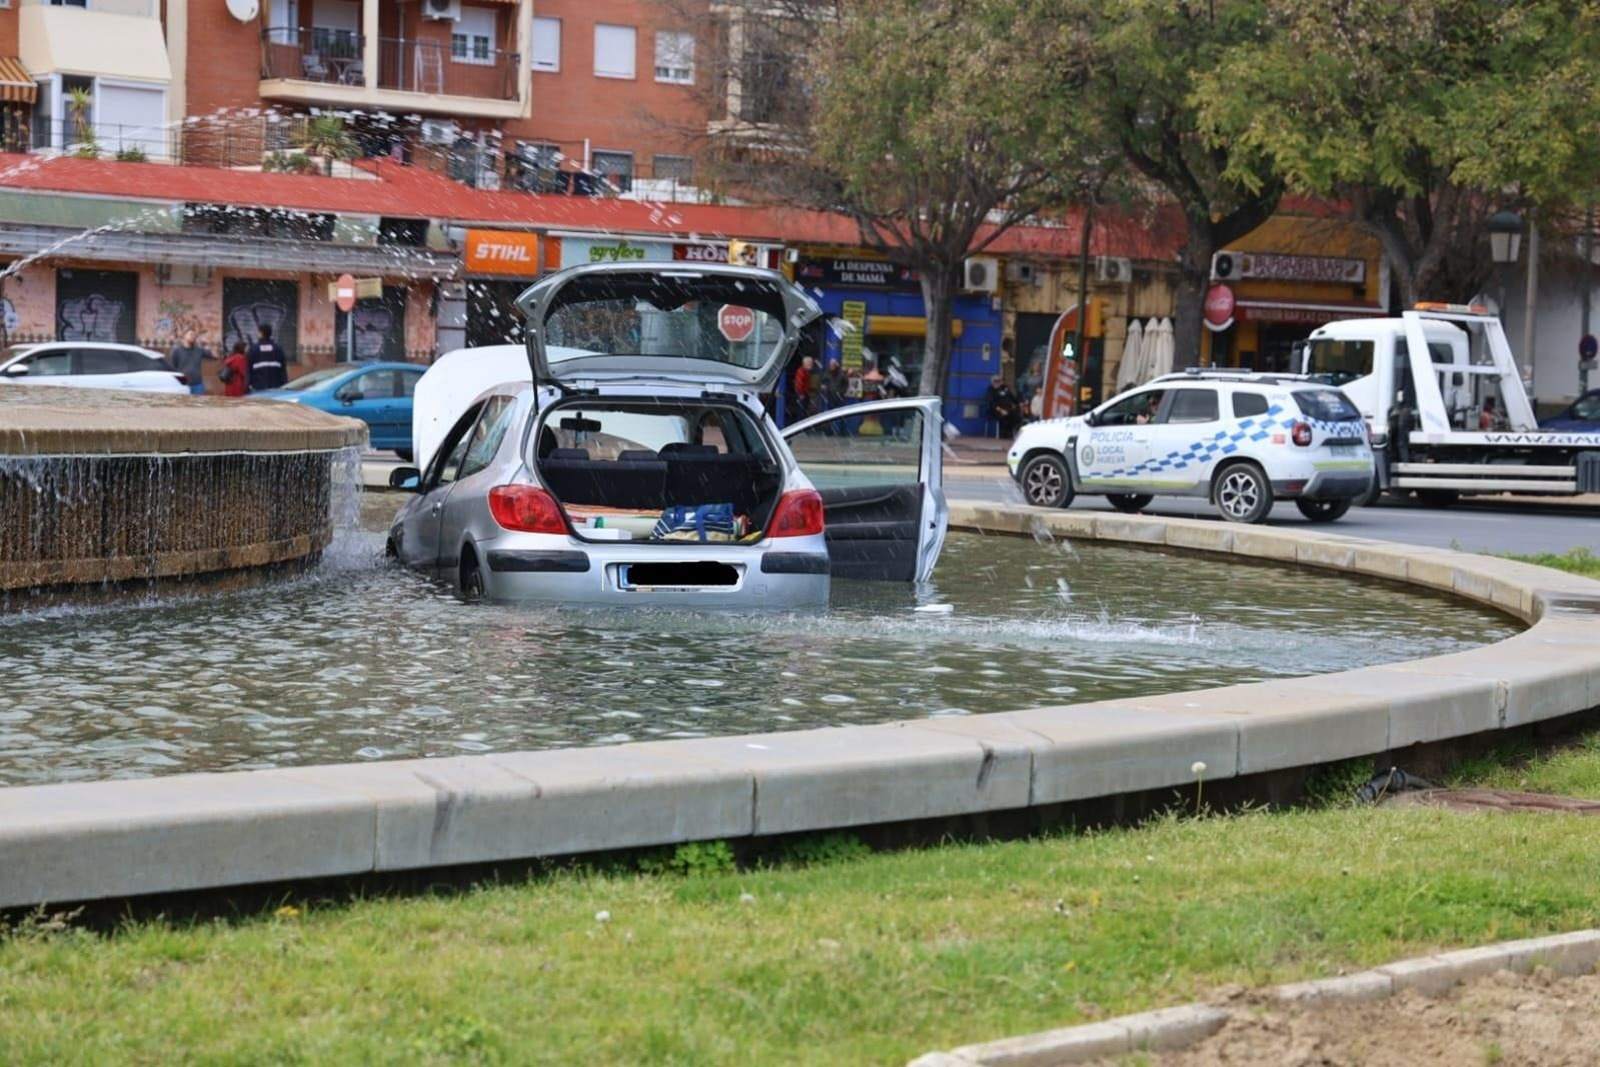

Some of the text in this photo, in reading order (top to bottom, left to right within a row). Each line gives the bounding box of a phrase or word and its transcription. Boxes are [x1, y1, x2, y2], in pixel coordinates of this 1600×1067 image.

[475, 243, 531, 262] STIHL
[833, 260, 846, 271] LA
[841, 272, 855, 283] DE
[723, 314, 752, 327] STOP
[1090, 430, 1134, 443] POLICÍA
[1097, 446, 1125, 454] LOCAL
